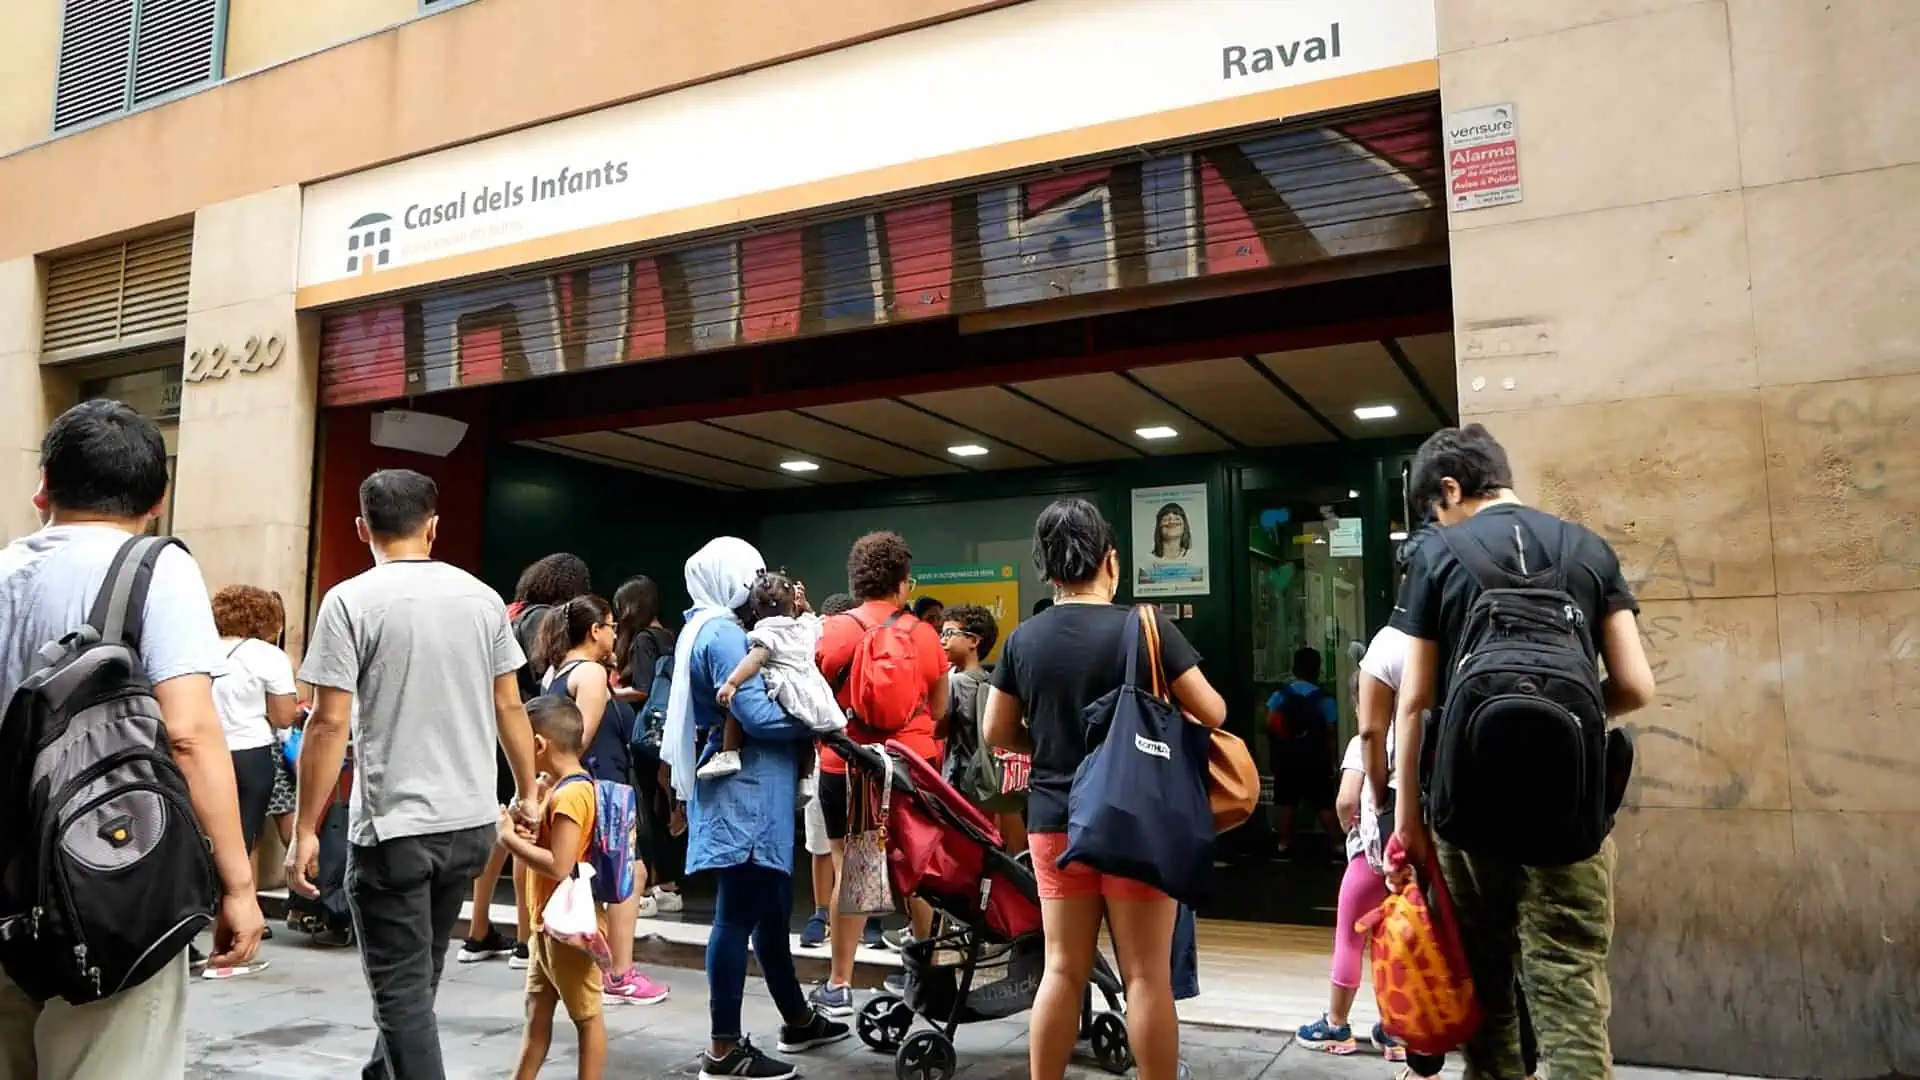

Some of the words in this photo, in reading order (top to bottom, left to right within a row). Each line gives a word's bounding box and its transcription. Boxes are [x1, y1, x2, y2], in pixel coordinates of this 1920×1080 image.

[1222, 21, 1341, 80] Raval
[1450, 120, 1512, 138] verisure
[1452, 146, 1514, 165] Alarma
[404, 191, 466, 230] Casal
[473, 181, 524, 215] dels
[531, 159, 629, 202] Infants
[184, 331, 287, 384] 22-20
